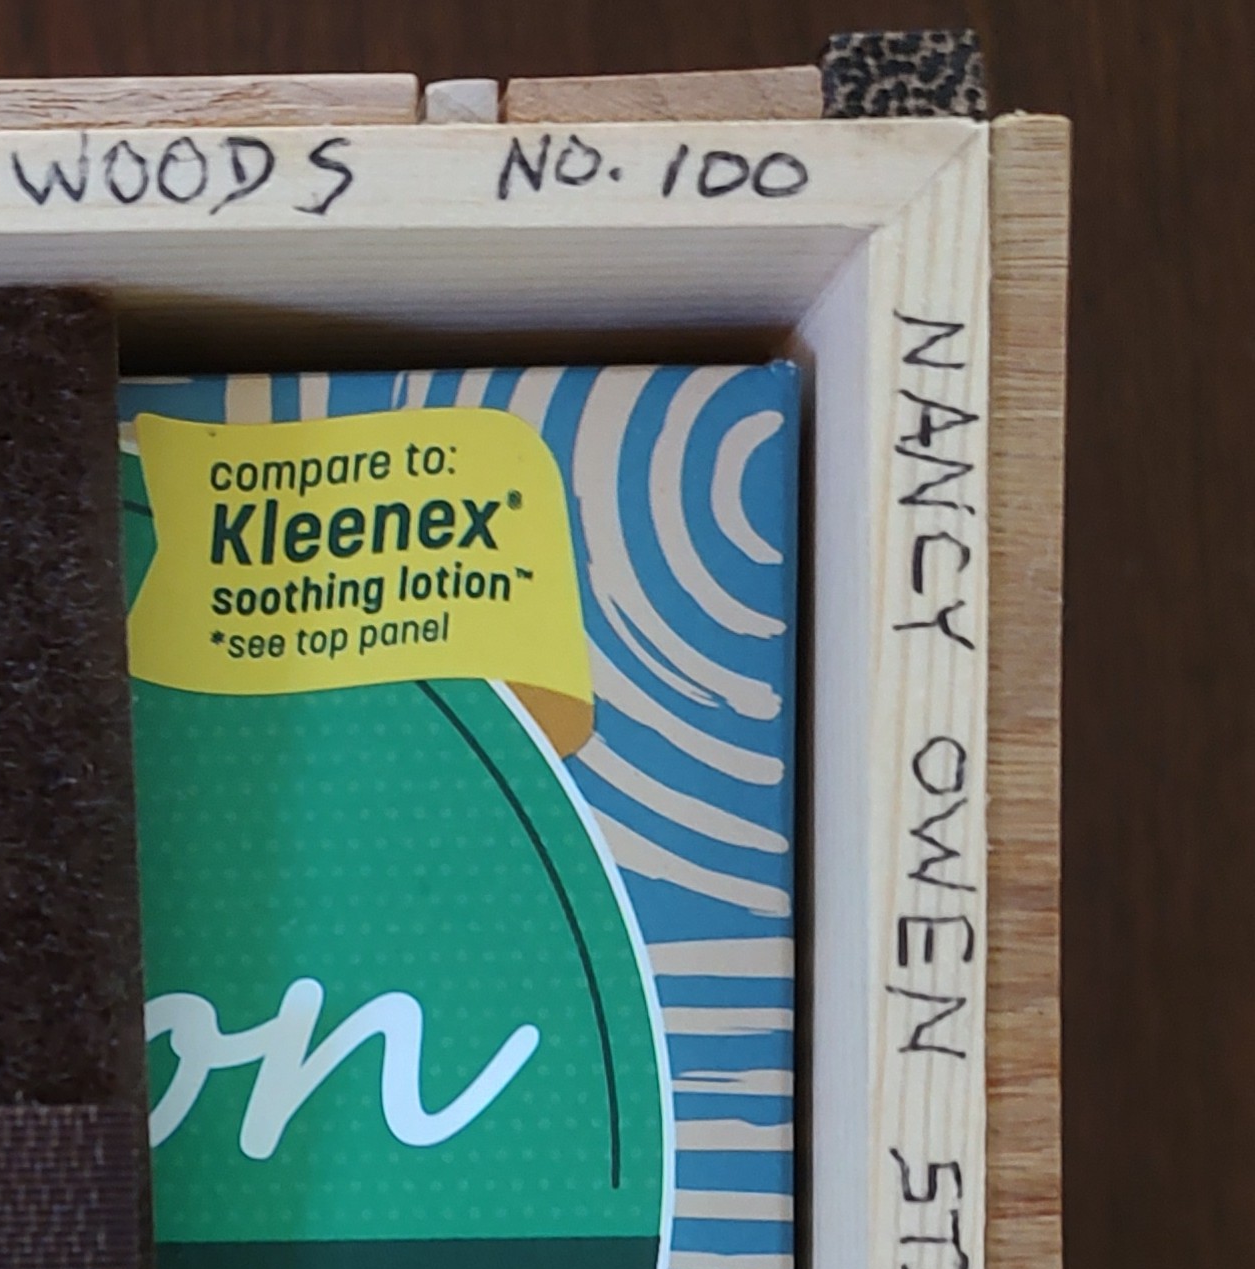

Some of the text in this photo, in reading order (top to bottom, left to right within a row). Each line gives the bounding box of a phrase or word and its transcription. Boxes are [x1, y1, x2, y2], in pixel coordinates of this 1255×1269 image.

[495, 132, 625, 200] NO.
[661, 140, 811, 202] 100
[209, 442, 459, 498] compare to:
[891, 308, 981, 652] NANCY
[209, 576, 385, 620] soothing
[295, 625, 351, 660] top
[357, 612, 451, 655] panel
[886, 736, 977, 1060] OWEN
